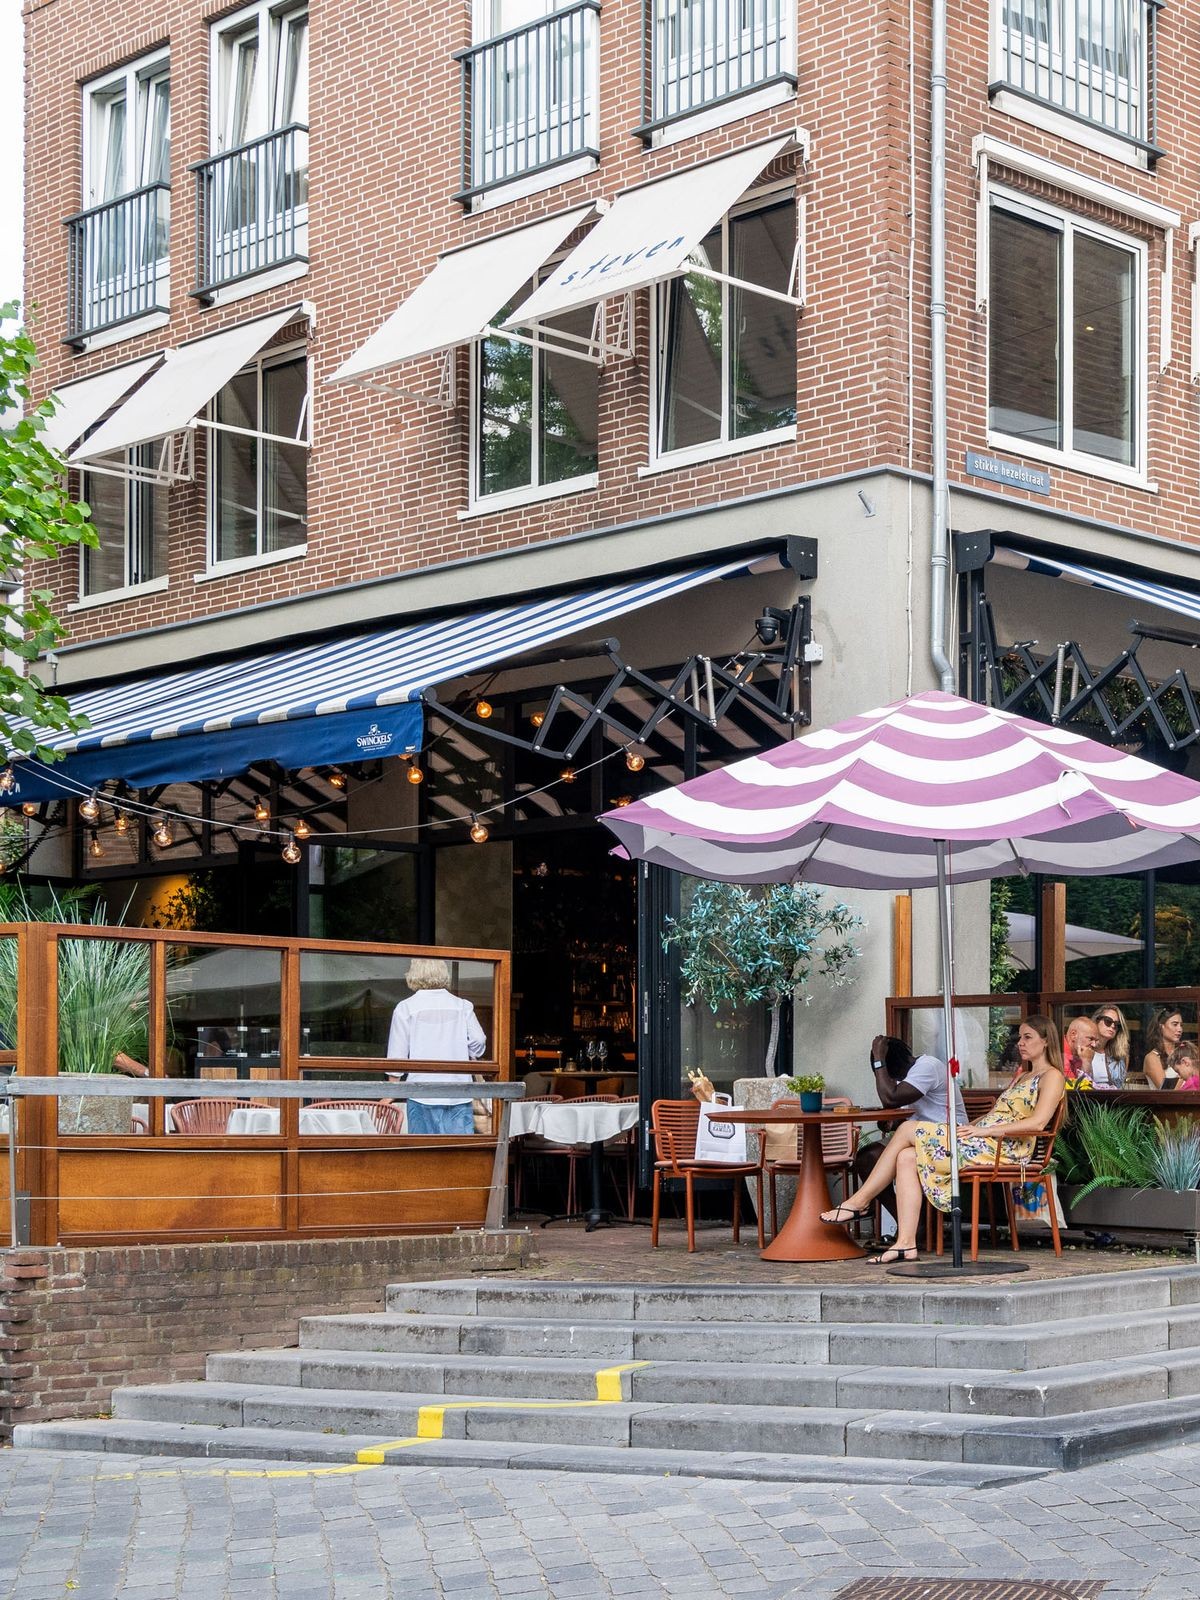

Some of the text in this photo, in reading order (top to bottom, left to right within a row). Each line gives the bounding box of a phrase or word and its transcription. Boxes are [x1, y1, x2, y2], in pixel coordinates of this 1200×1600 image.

[560, 236, 685, 286] steven
[974, 459, 1045, 488] stikke hezelstraat
[356, 733, 393, 747] SWINCKELS
